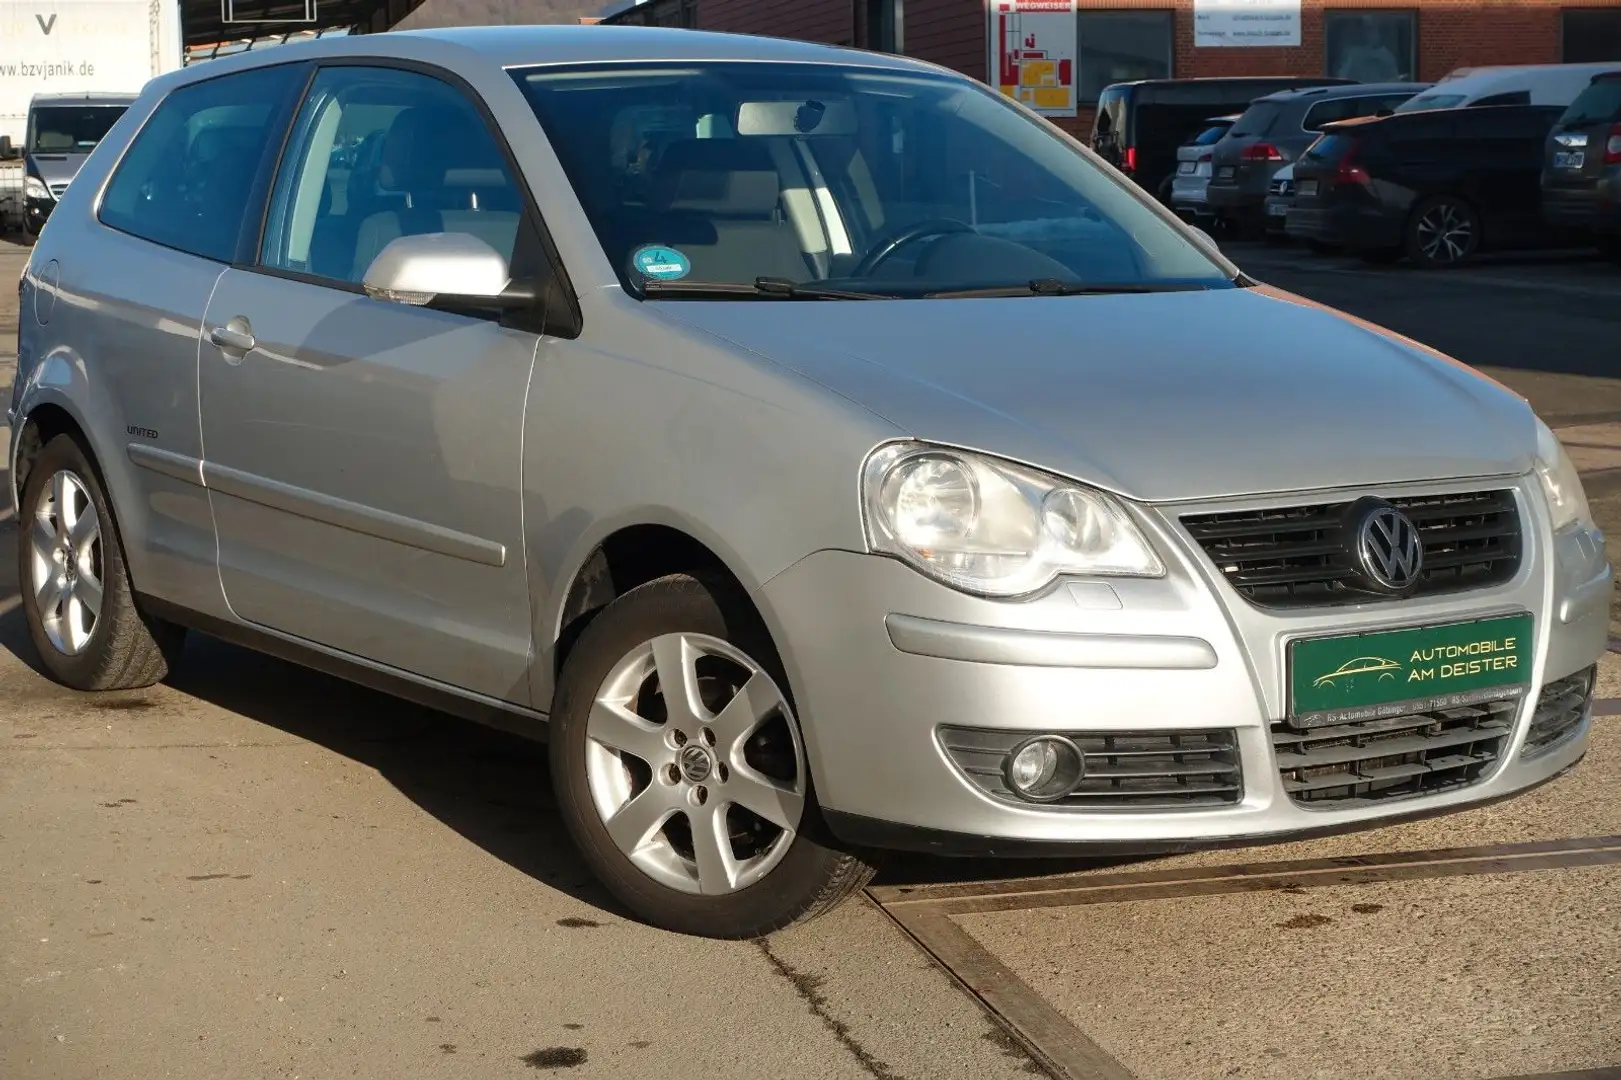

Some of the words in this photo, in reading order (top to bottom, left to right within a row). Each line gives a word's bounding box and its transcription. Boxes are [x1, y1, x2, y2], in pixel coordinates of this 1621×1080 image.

[1410, 637, 1517, 663] AUTOMOBILE
[1407, 668, 1434, 683] AM
[1440, 655, 1518, 679] DEISTER
